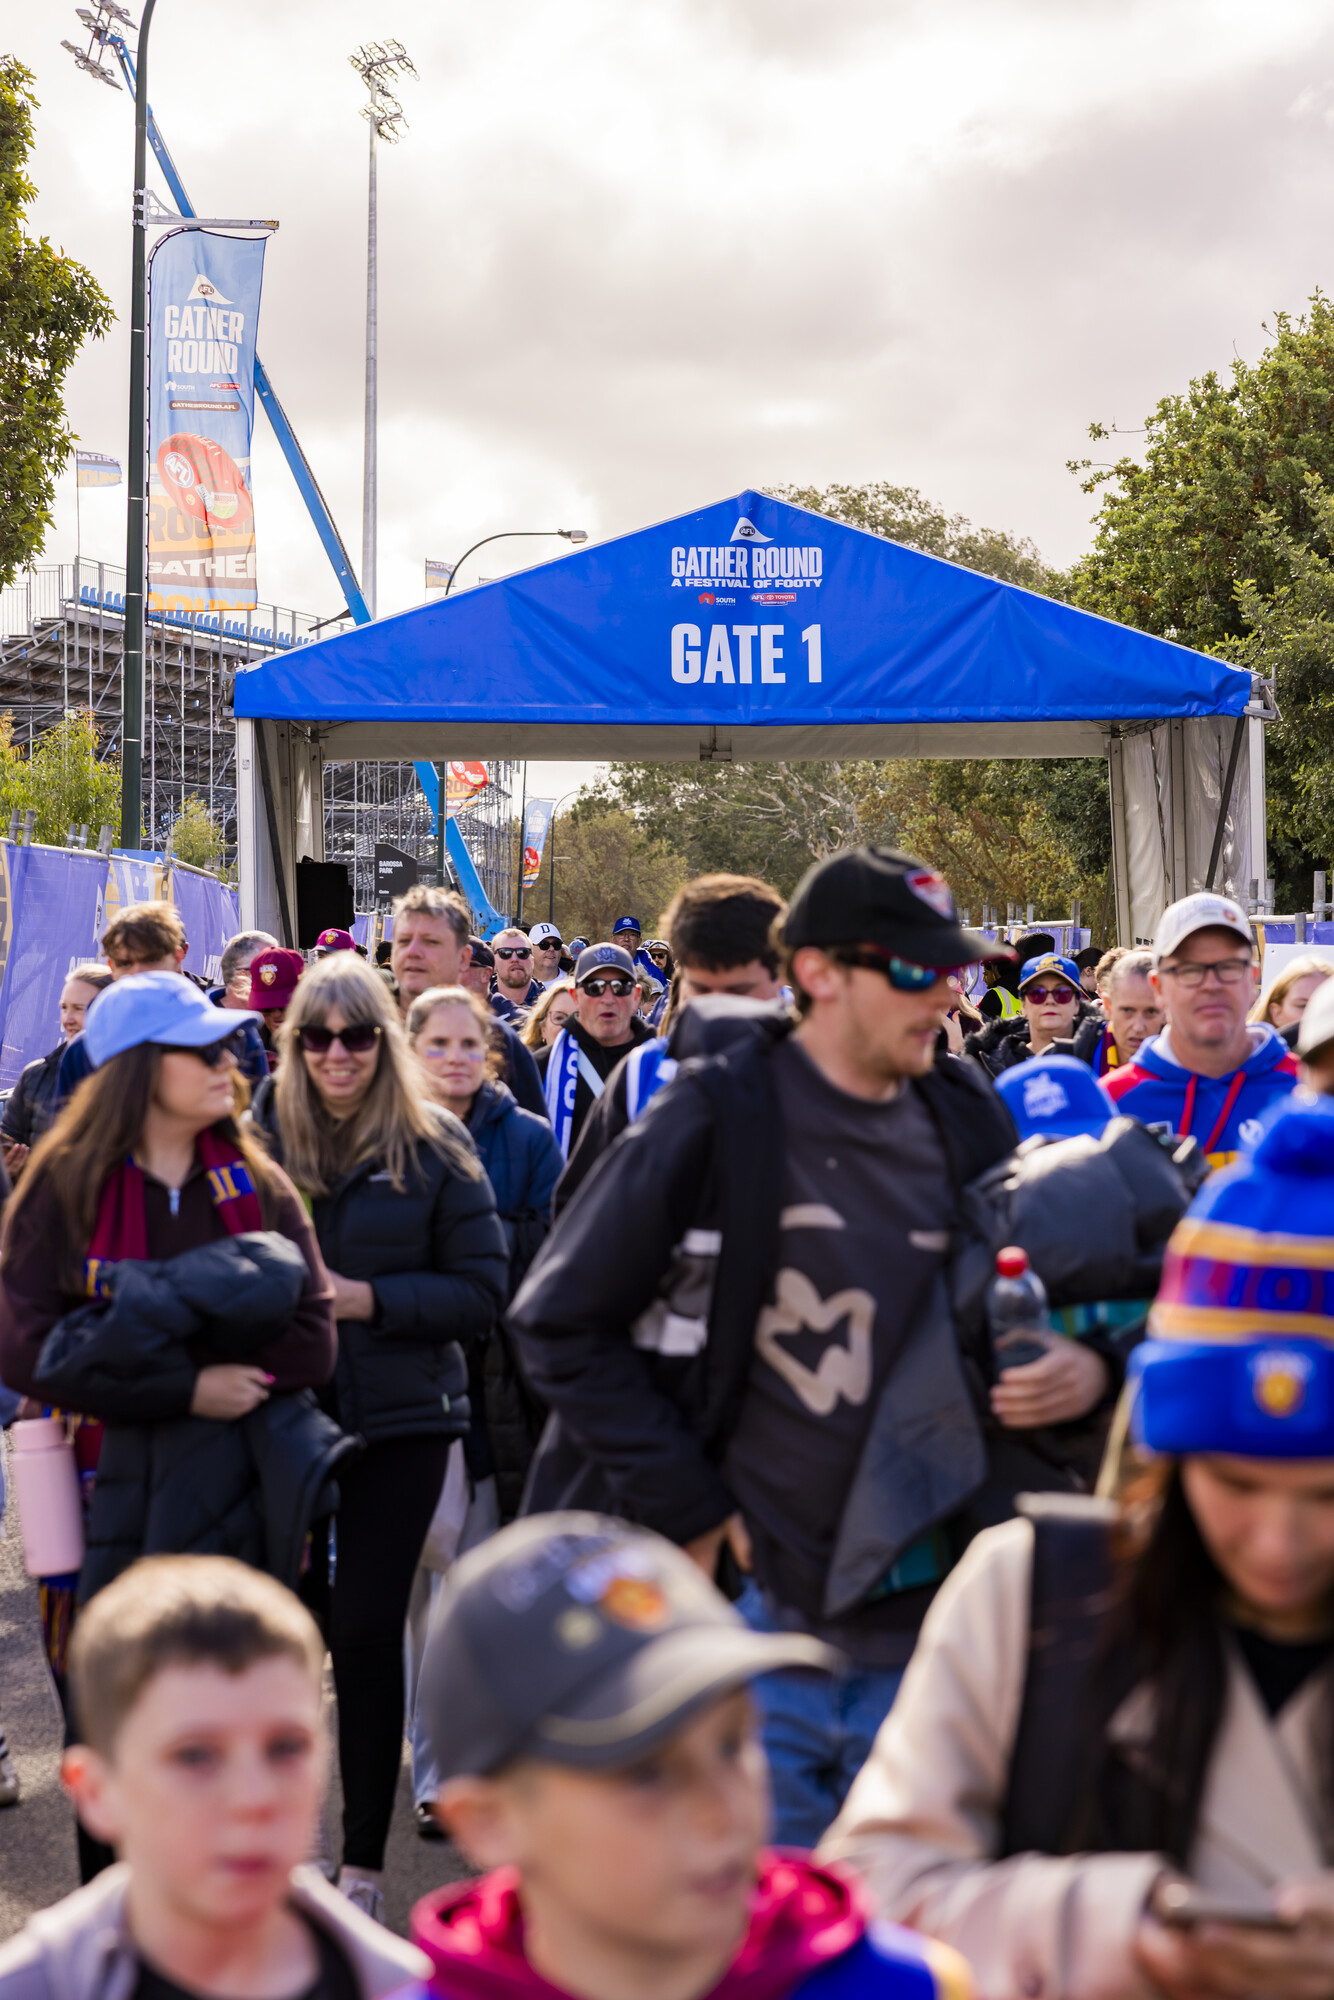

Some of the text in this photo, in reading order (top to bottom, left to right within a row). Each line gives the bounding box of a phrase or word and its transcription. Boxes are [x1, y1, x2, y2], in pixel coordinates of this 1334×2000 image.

[164, 305, 245, 344] GATHER
[167, 340, 238, 375] ROUND
[164, 455, 190, 486] AFL
[740, 527, 755, 535] AFL
[671, 546, 823, 578] GATHER ROUND
[671, 578, 822, 588] A FESTIVAL OF FOOTY
[671, 623, 823, 684] GATE 1
[541, 925, 550, 934] D
